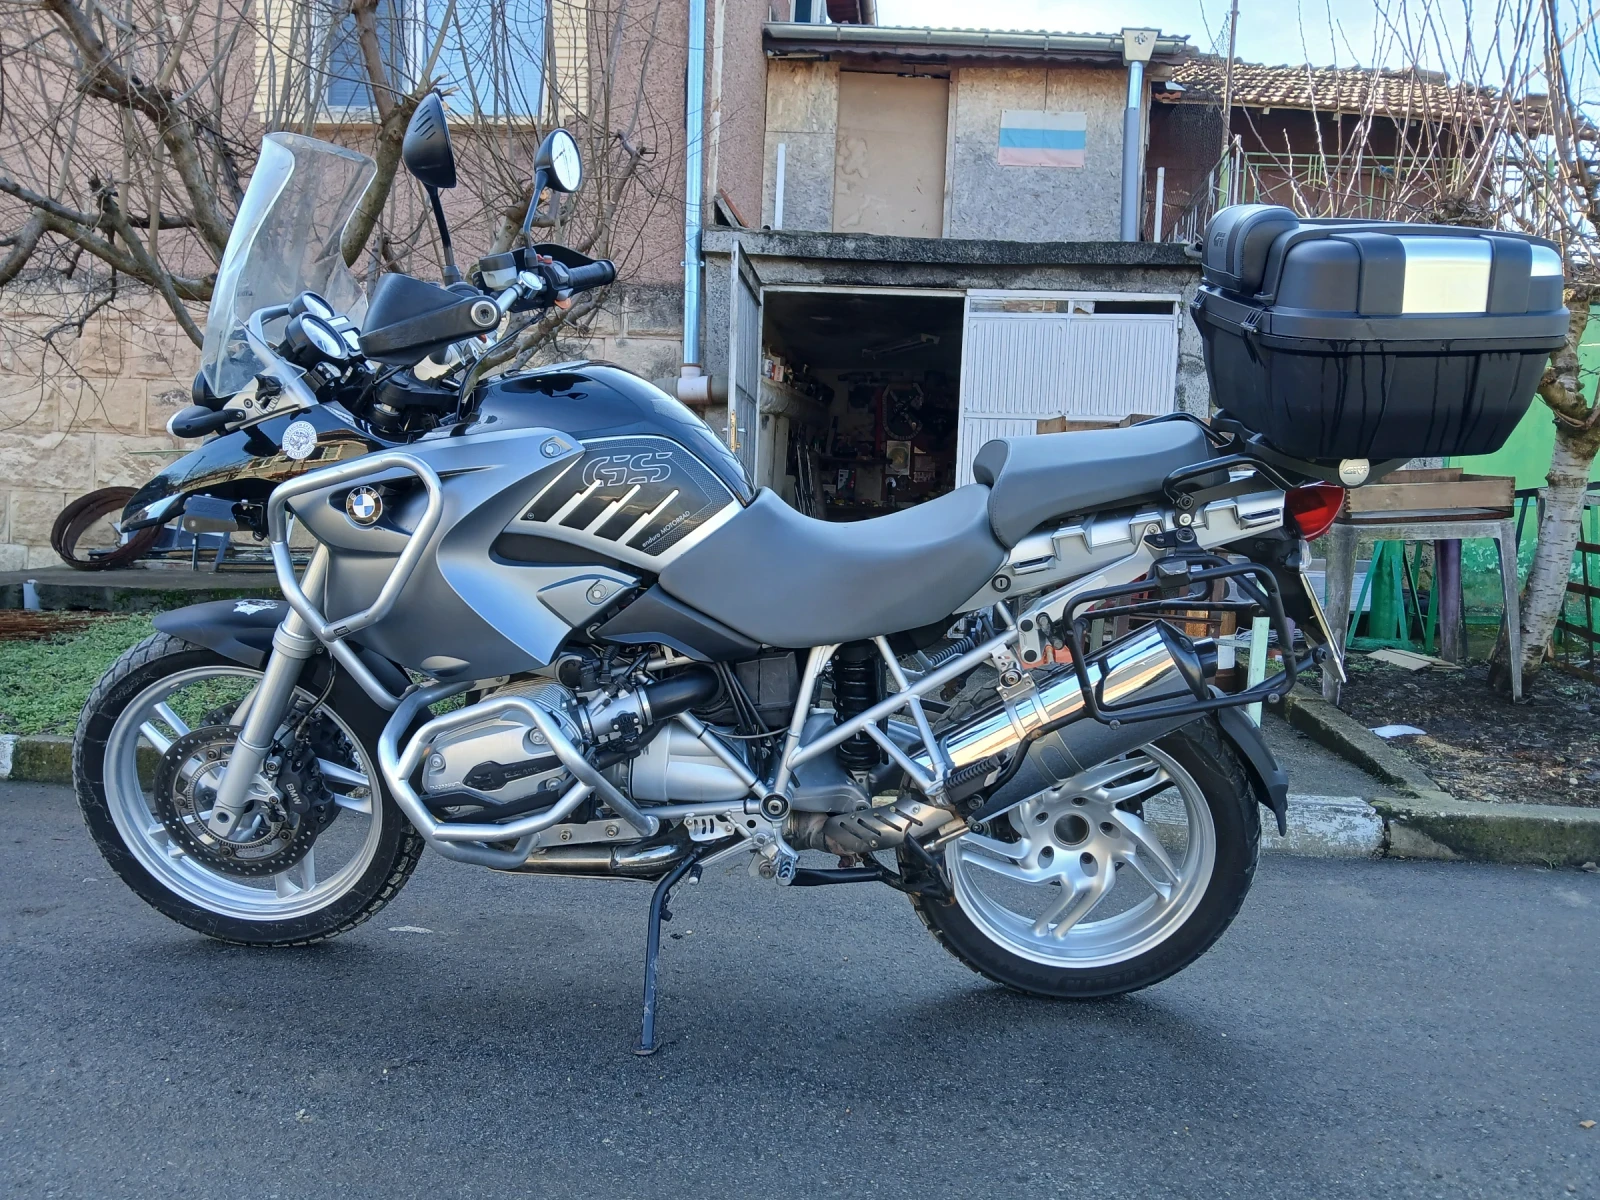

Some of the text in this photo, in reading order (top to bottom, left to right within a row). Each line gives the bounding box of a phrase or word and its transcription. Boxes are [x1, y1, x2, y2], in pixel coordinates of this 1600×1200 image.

[582, 452, 673, 487] GS
[642, 510, 691, 548] enduro MOTORRAD
[286, 783, 302, 805] BMW
